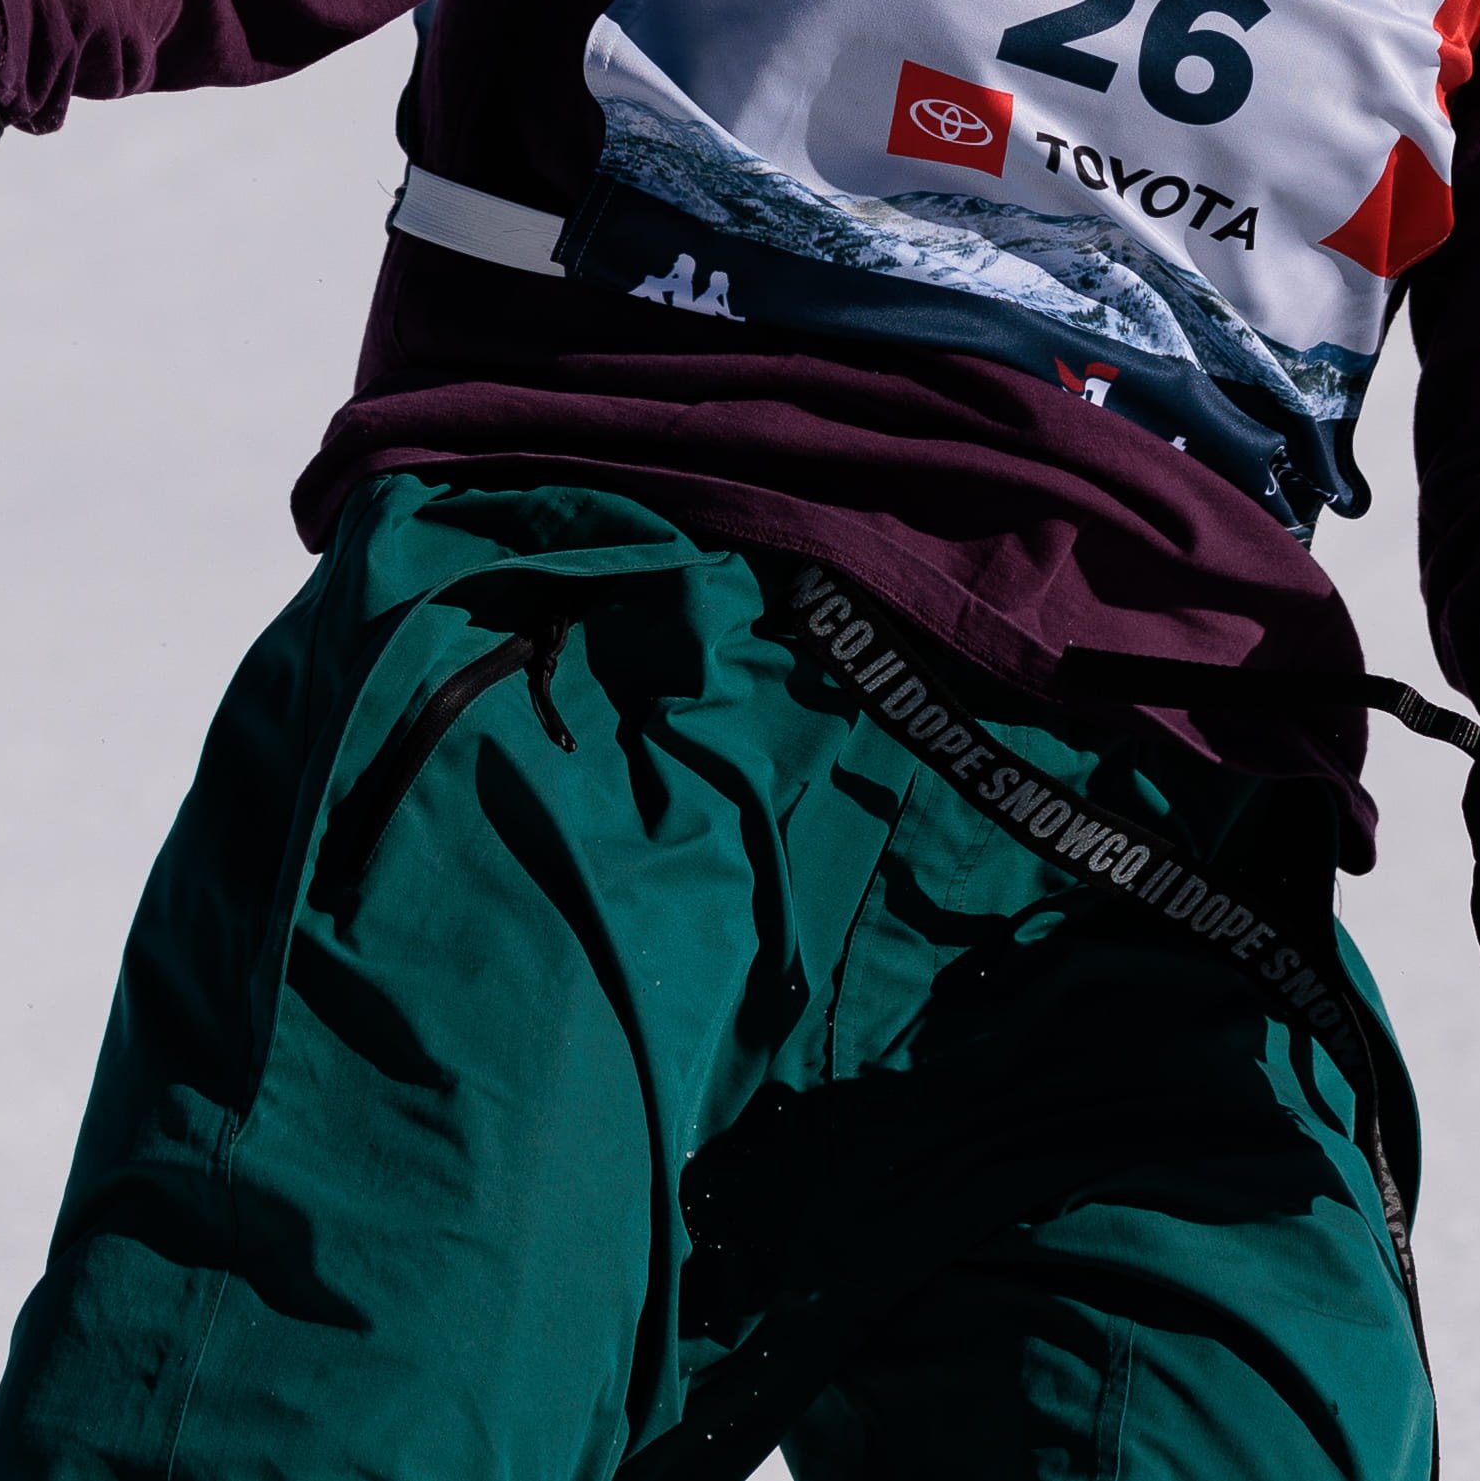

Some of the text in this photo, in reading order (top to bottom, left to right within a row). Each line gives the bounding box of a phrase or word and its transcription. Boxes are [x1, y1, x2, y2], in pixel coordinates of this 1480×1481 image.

[1036, 131, 1261, 252] TOYOTA
[879, 674, 996, 781] DOPE
[1163, 874, 1278, 960] DOPE
